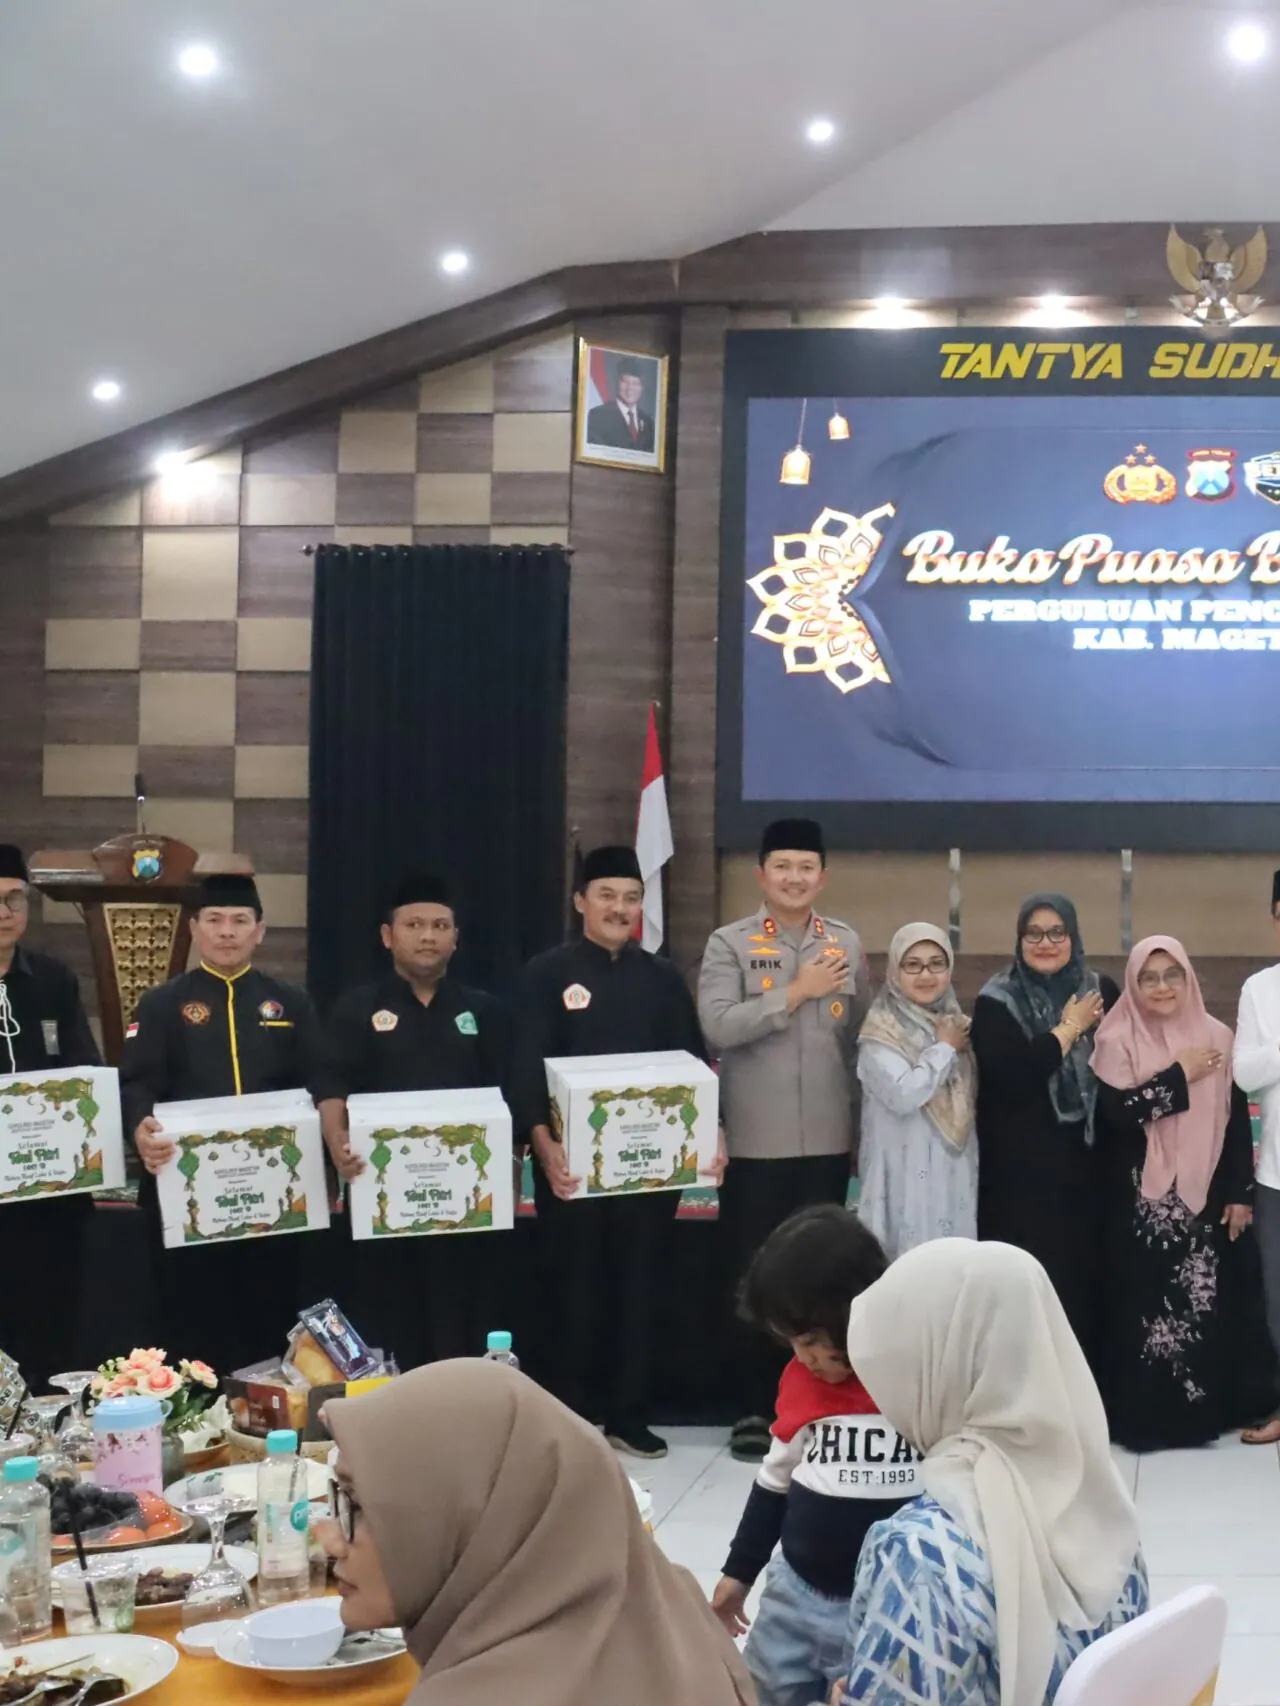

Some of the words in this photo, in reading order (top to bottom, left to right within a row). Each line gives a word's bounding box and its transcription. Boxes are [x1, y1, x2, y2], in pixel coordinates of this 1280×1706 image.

[939, 343, 1123, 380] TANTYA
[903, 530, 1060, 585] Buka
[1058, 531, 1246, 586] Puasa
[969, 600, 1182, 623] PERGURUAN
[750, 960, 782, 969] ERIK
